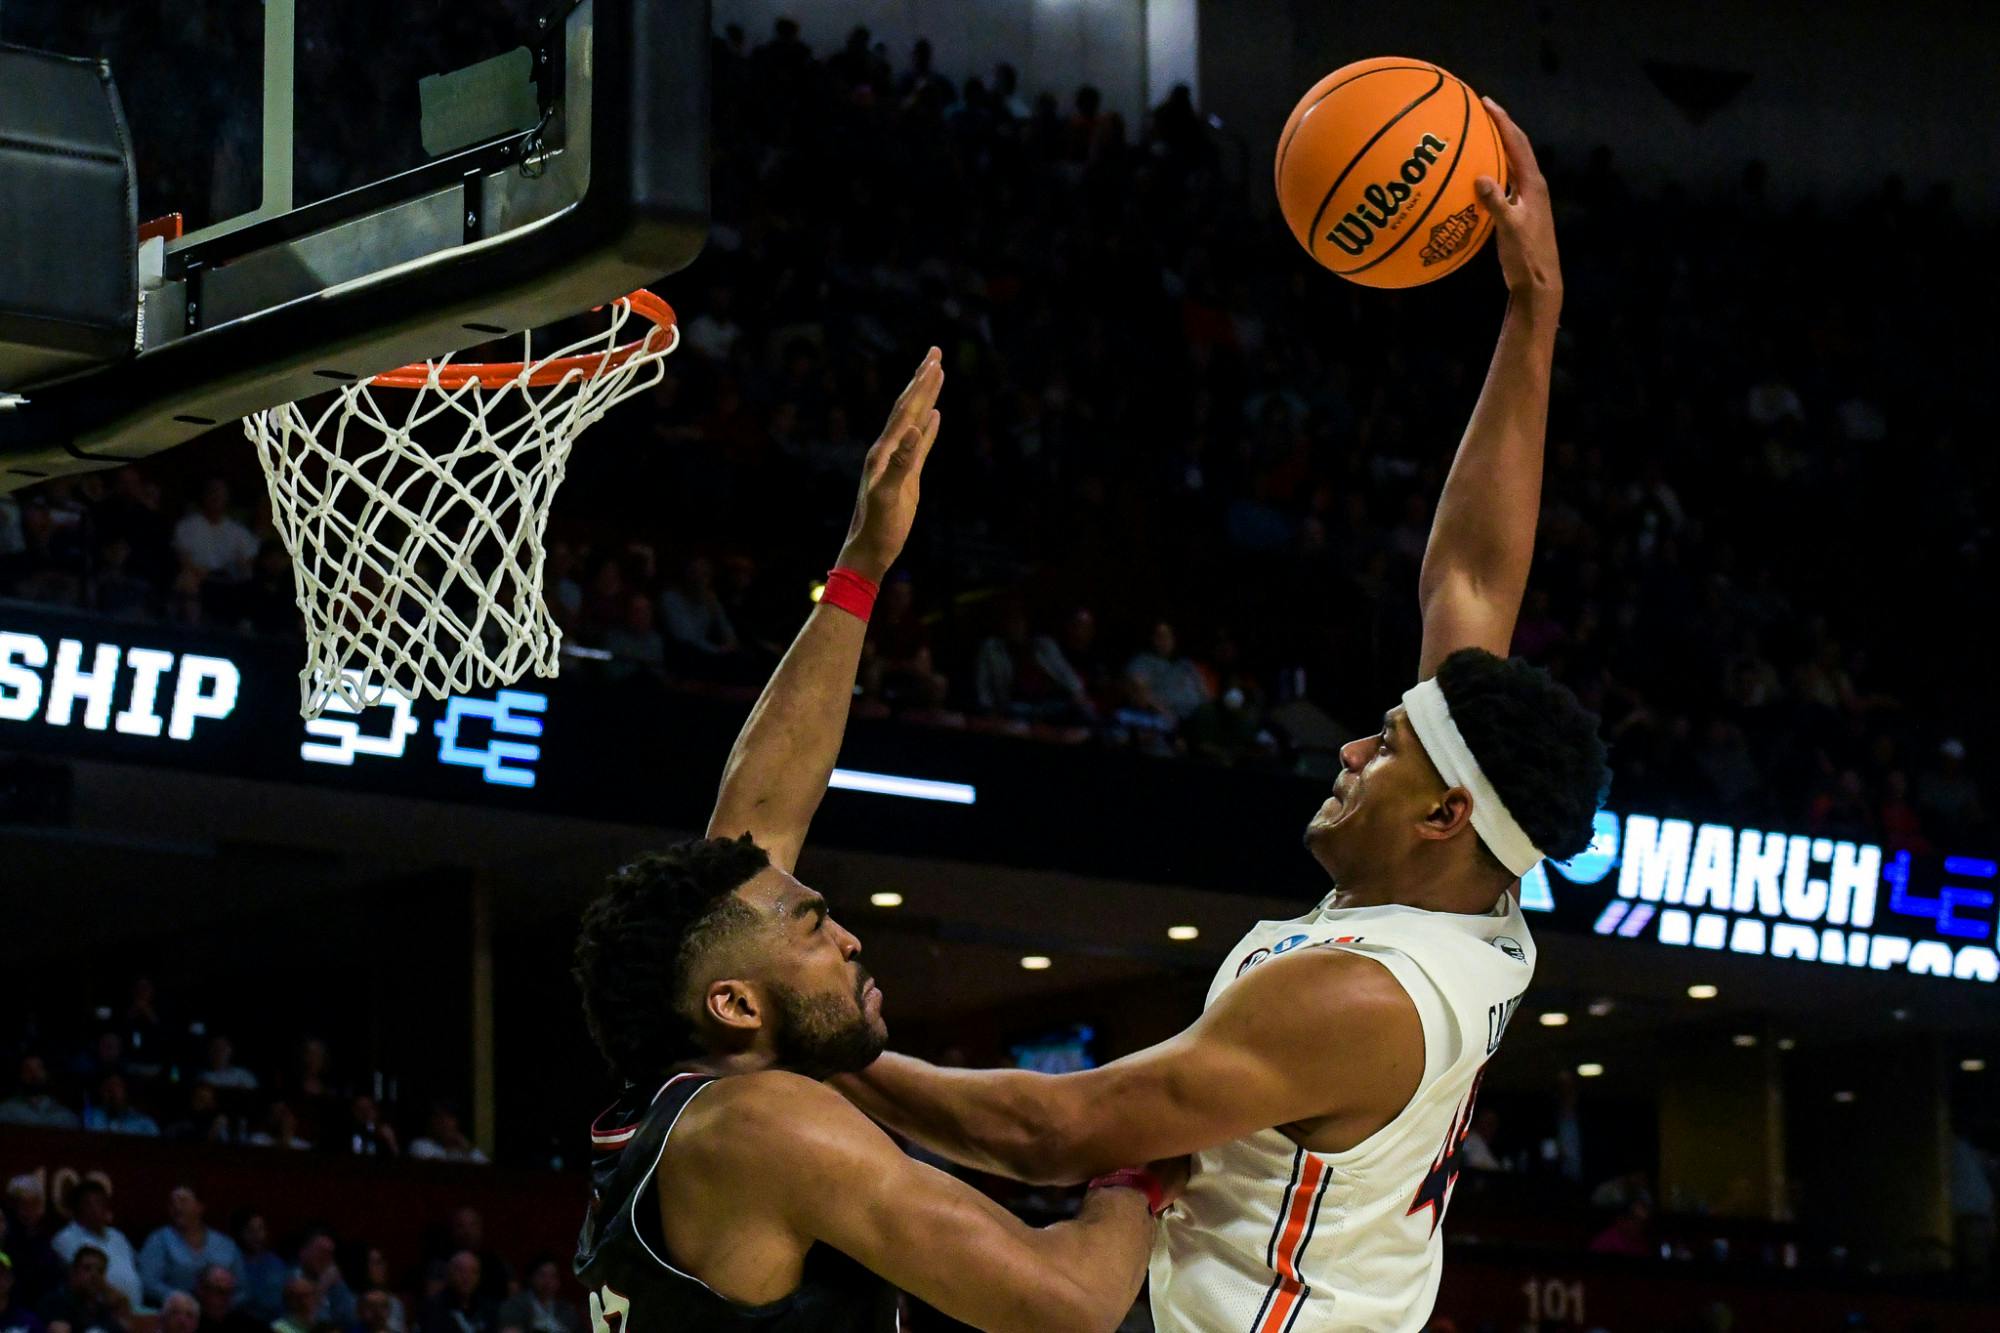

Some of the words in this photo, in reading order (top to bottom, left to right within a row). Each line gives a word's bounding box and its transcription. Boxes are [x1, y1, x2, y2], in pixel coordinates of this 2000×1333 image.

[1326, 133, 1447, 256] Wilson
[1430, 216, 1460, 250] FINAL
[1439, 221, 1468, 257] FOUR
[0, 631, 240, 741] SHIP
[1617, 814, 1881, 929] MARCH
[1520, 1275, 1585, 1325] 101
